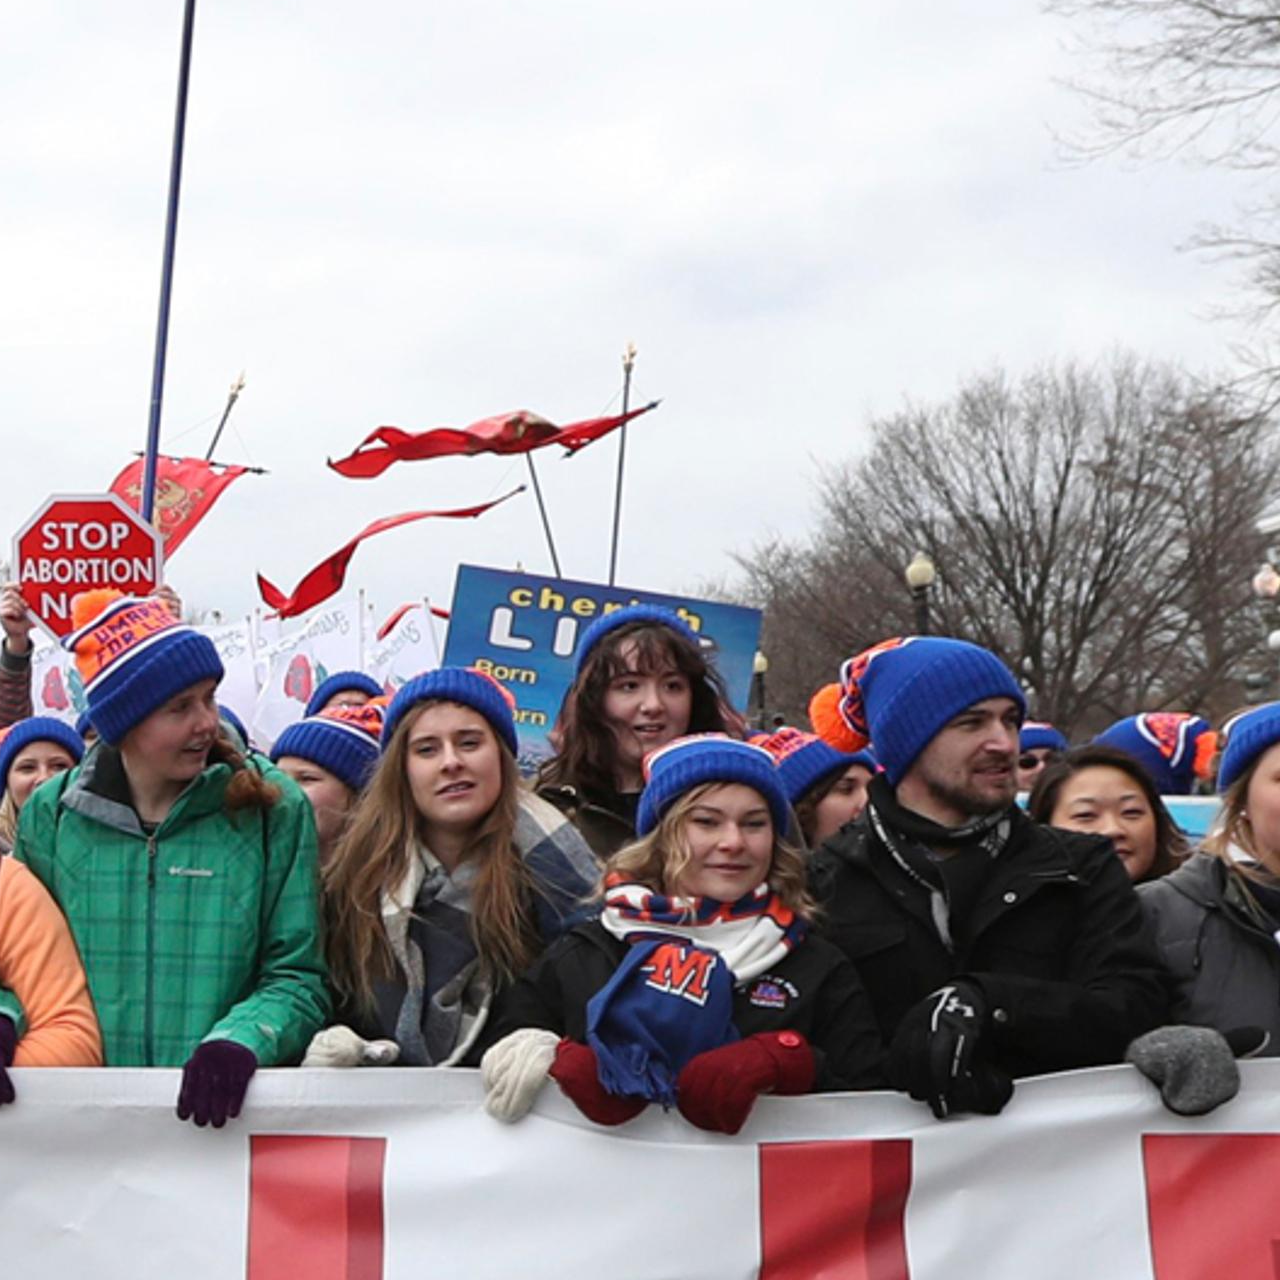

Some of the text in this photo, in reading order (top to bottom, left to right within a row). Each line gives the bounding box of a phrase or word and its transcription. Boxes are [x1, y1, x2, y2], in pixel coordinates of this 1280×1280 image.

[41, 522, 130, 551] STOP
[21, 557, 154, 584] ABORTION
[474, 658, 538, 685] Born
[641, 943, 717, 1007] M
